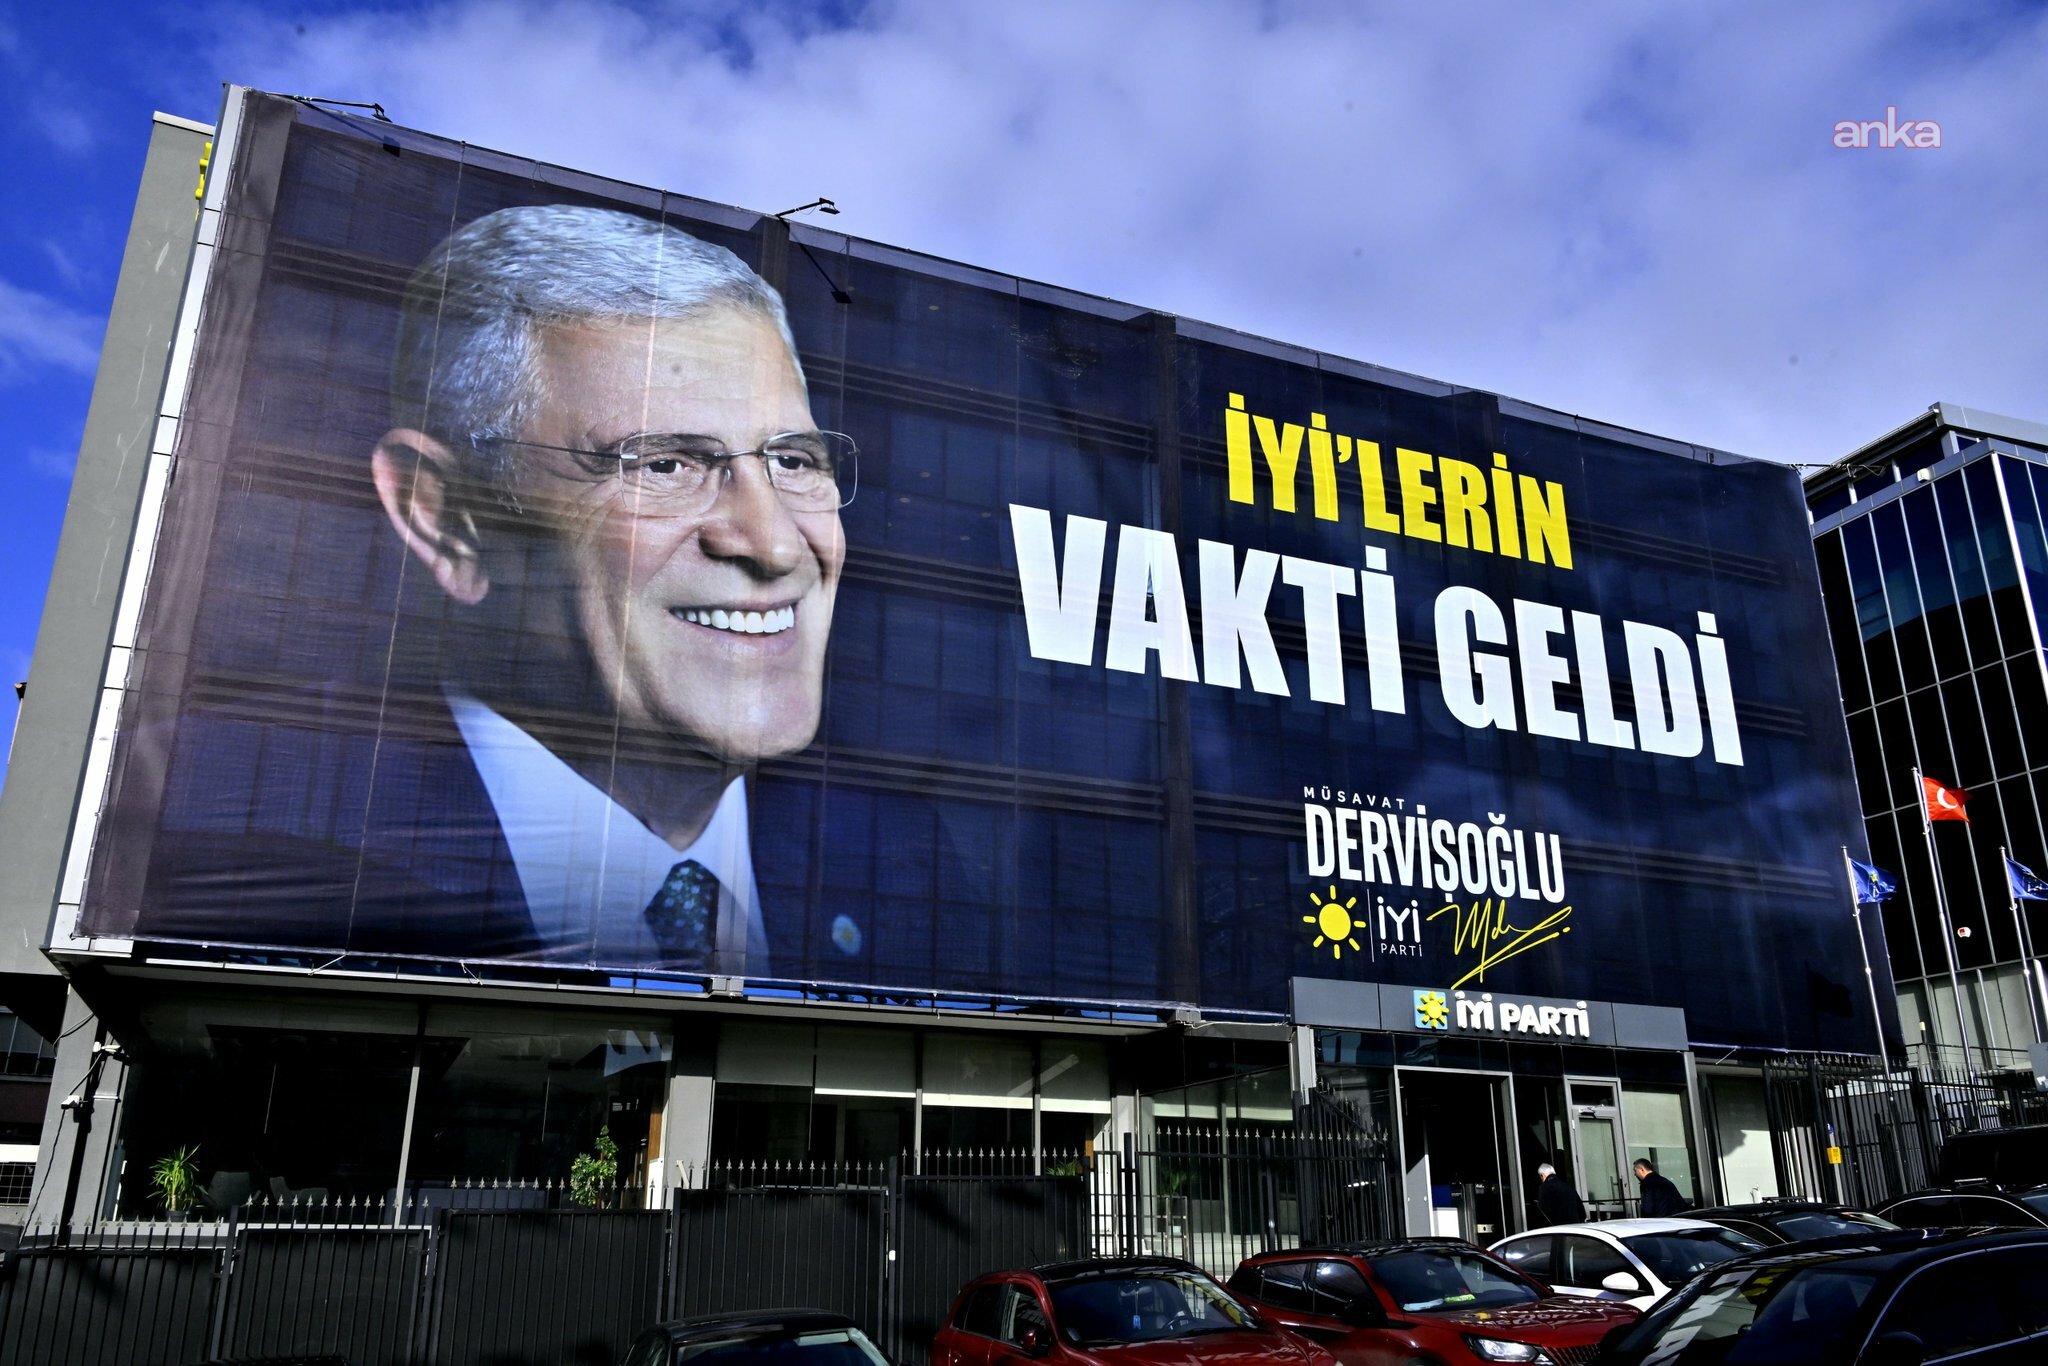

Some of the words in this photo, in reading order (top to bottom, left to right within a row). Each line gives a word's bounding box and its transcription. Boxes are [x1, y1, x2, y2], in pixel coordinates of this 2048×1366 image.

[1009, 503, 1406, 715] VAKTİ
[1434, 585, 1744, 767] GELDİ
[1303, 786, 1405, 809] MÜSAVAT
[1304, 804, 1566, 904] DERVİŞOĞLU
[1377, 896, 1421, 943] İYİ
[1380, 943, 1423, 957] PARTİ
[1455, 991, 1495, 1031] İYİ
[1500, 1000, 1590, 1039] PARTİ
